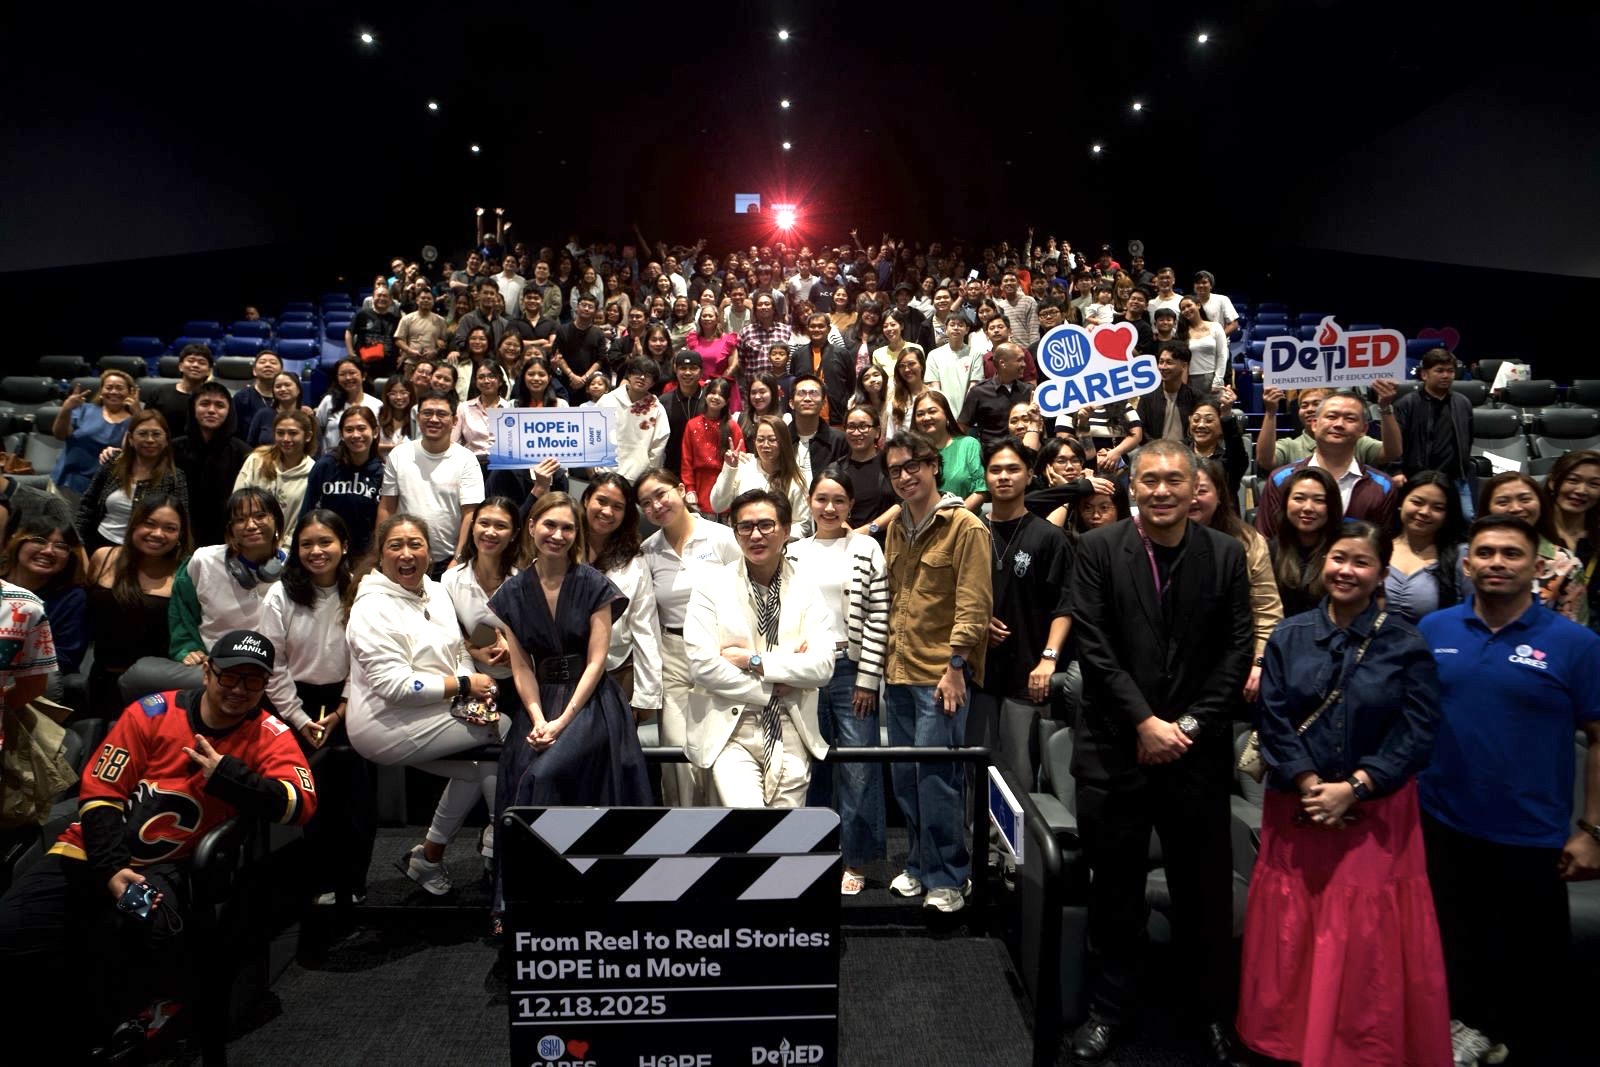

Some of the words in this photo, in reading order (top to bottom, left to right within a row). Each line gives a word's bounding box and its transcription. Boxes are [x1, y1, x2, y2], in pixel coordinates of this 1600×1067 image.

[1047, 333, 1085, 372] SM
[1038, 360, 1156, 412] CARES
[1271, 376, 1323, 385] DEPARTMENT
[1346, 372, 1394, 381] EDUCATION
[524, 422, 565, 433] HOPE
[567, 421, 579, 433] in
[526, 440, 535, 448] a
[537, 436, 578, 448] Movie
[232, 644, 267, 657] MANILA
[515, 931, 580, 952] From
[585, 929, 639, 951] Reel
[643, 931, 670, 950] to
[675, 928, 730, 949] Real
[735, 927, 830, 949] Stories:
[516, 959, 593, 980] HOPE
[598, 958, 620, 979] in
[625, 963, 641, 978] a
[647, 956, 721, 978] Movie
[518, 995, 667, 1018] 12.18.2025
